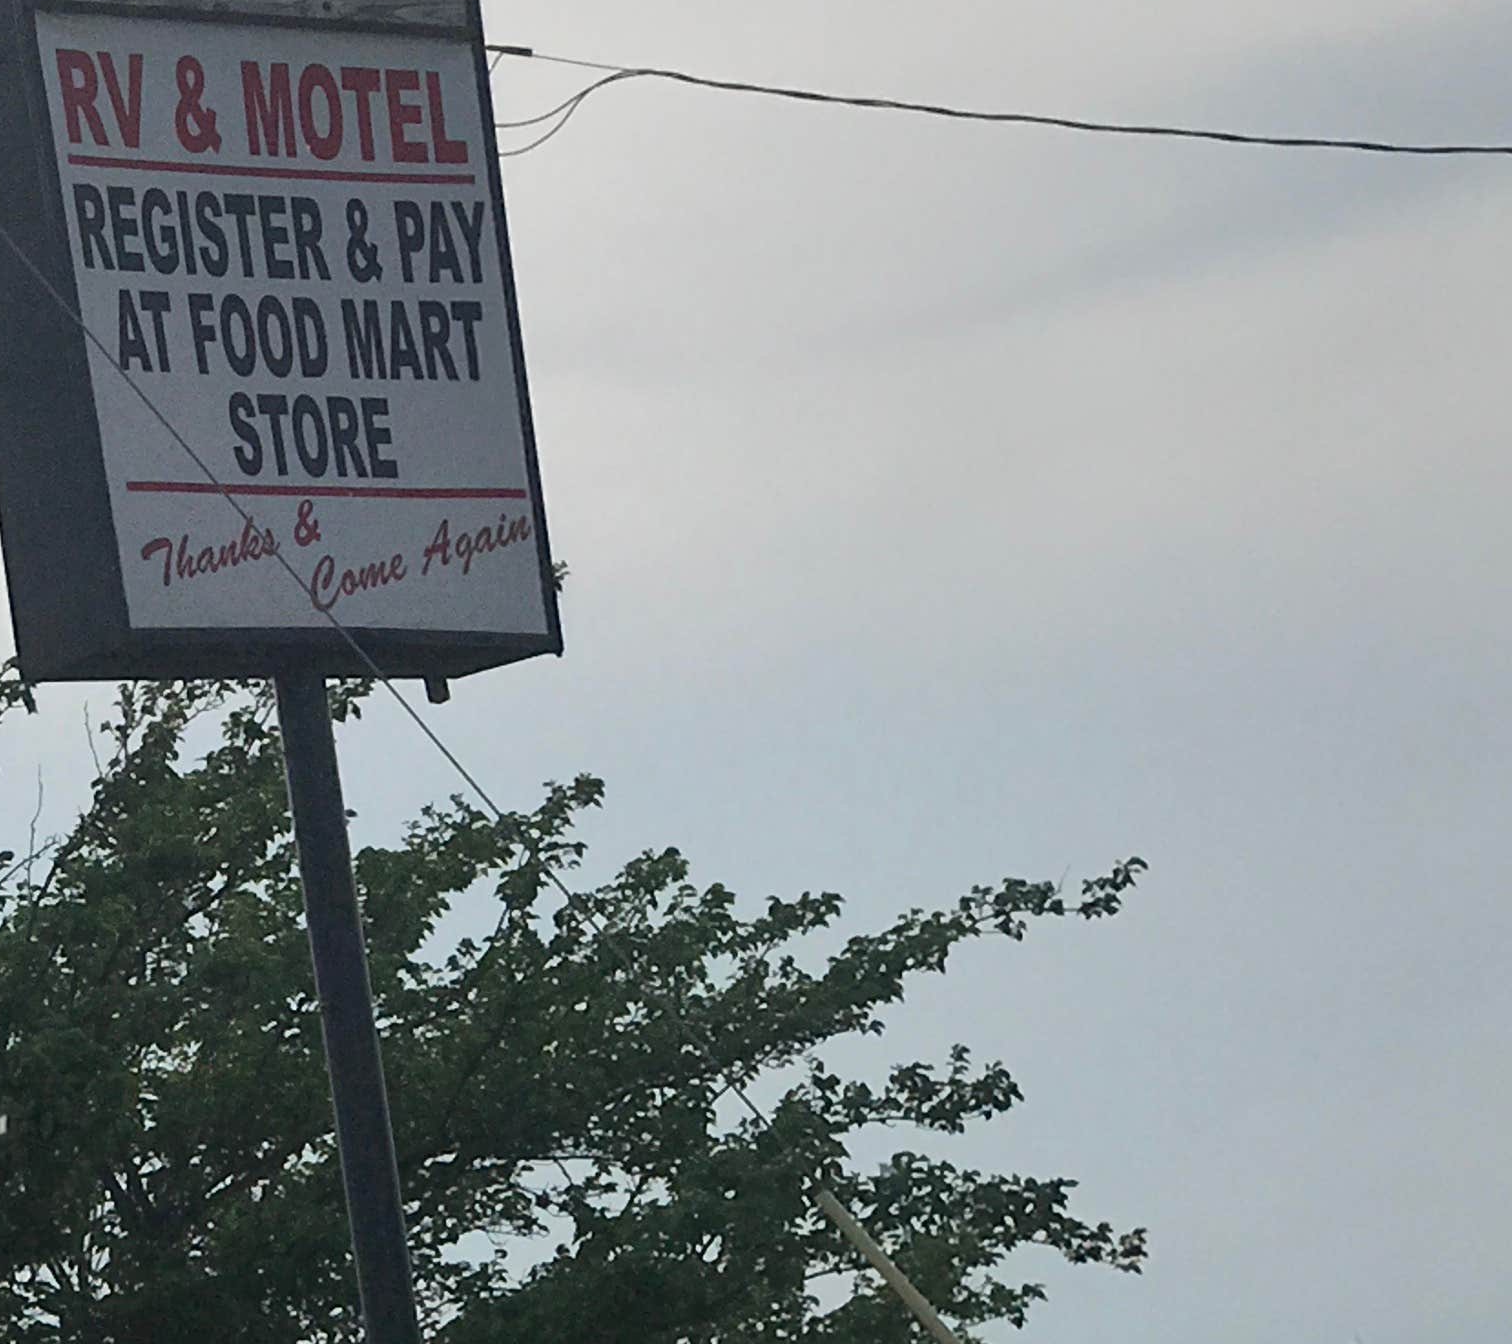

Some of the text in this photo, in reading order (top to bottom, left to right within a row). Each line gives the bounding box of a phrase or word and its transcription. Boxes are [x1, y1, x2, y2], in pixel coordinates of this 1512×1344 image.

[55, 49, 468, 164] RV & MOTEL
[73, 183, 484, 284] REGISTER & PAY
[118, 289, 482, 381] AT FOOD MART
[228, 392, 398, 479] STORE
[141, 499, 321, 586] Thanks &
[311, 515, 531, 612] Come Again
